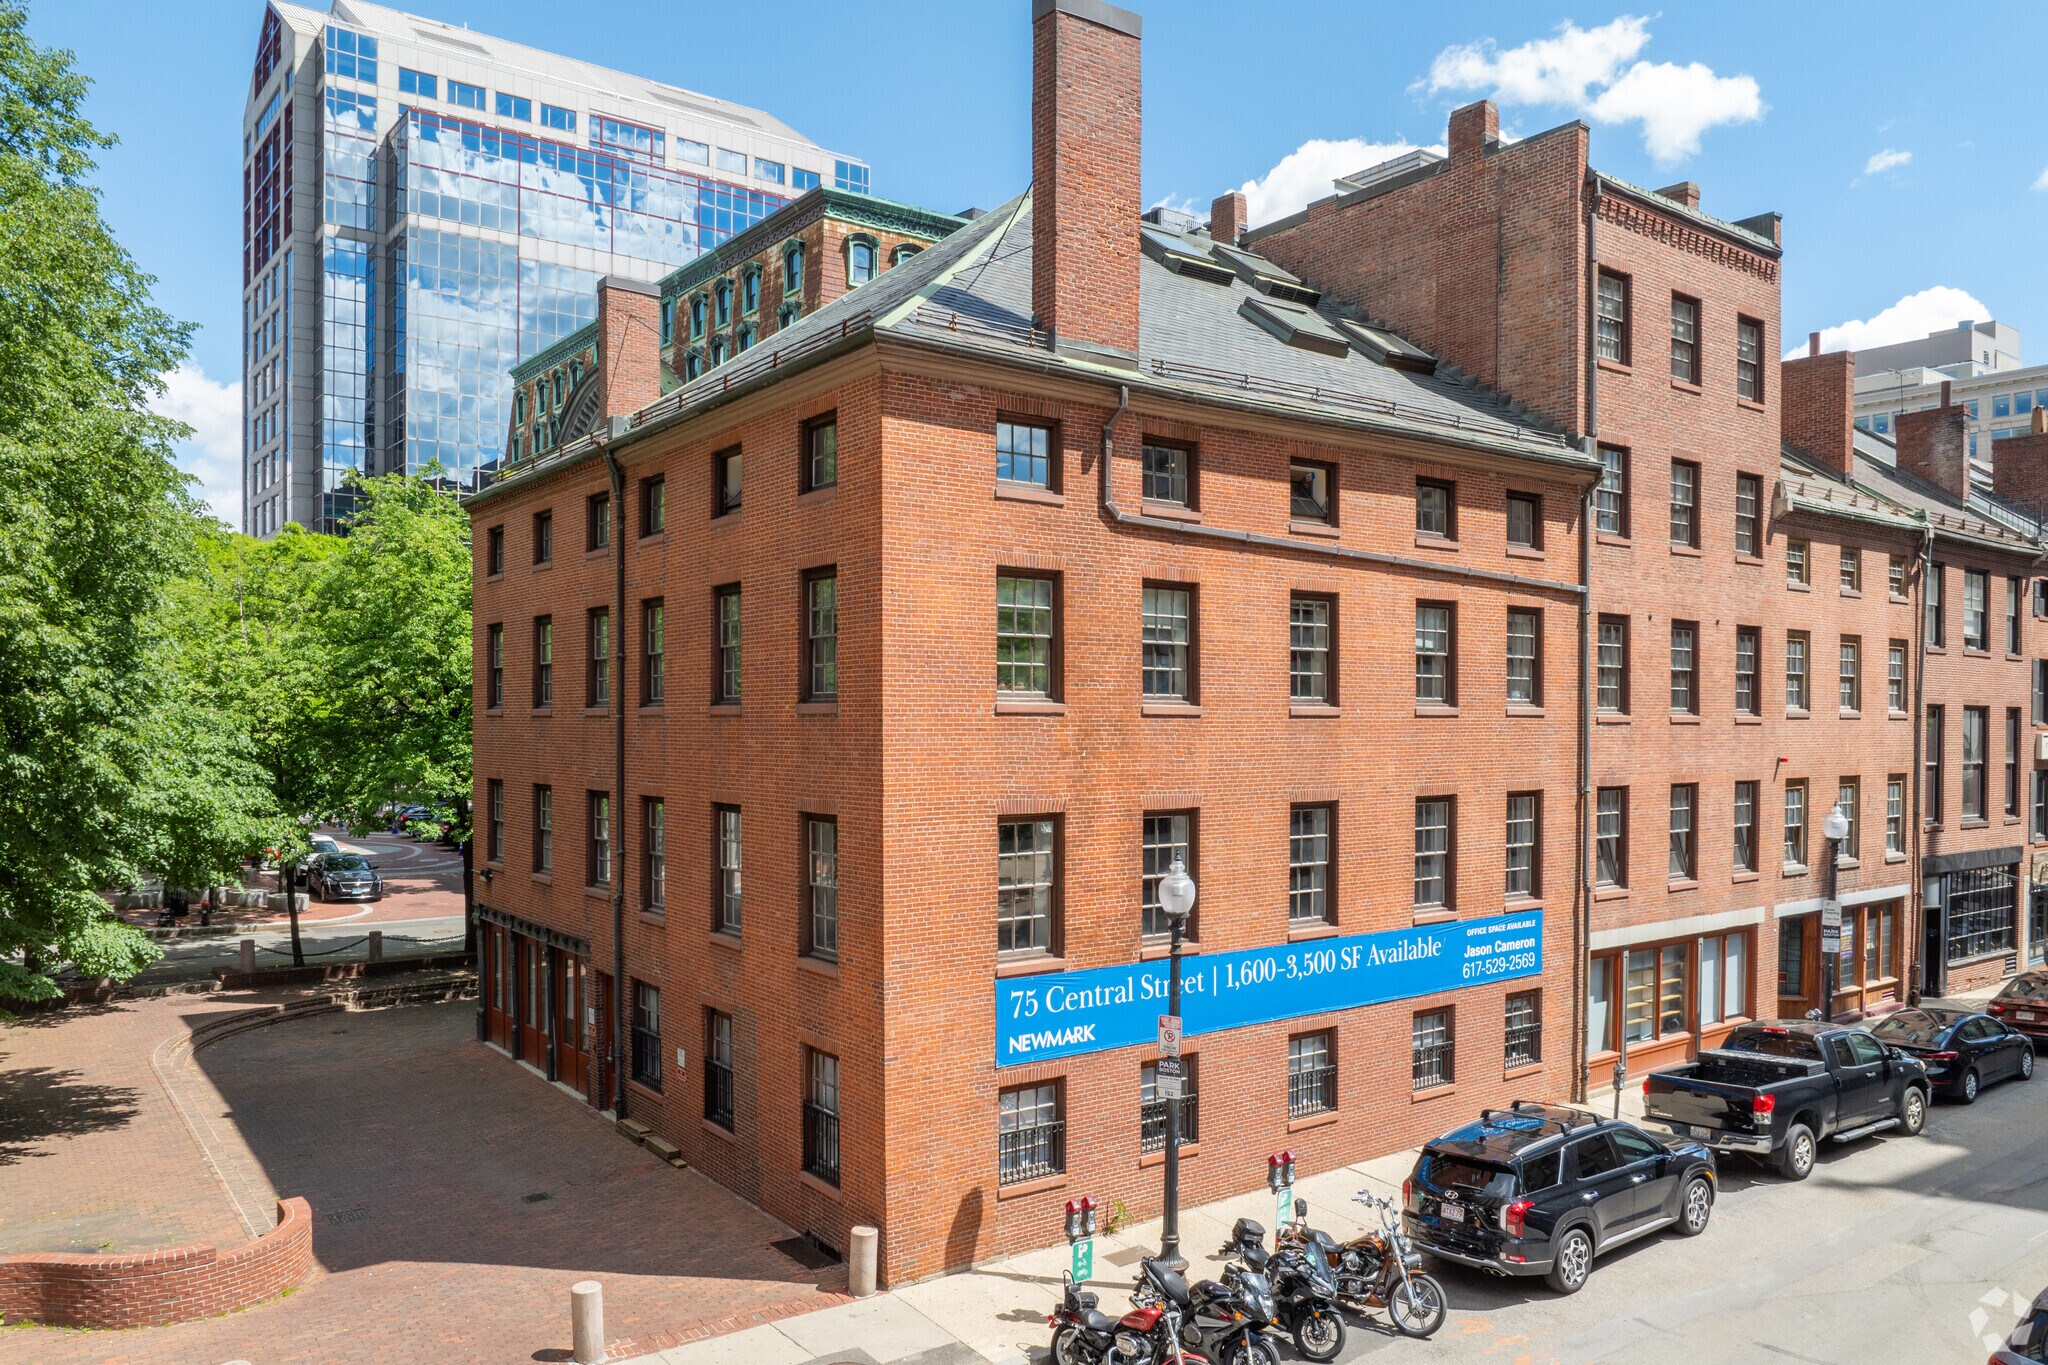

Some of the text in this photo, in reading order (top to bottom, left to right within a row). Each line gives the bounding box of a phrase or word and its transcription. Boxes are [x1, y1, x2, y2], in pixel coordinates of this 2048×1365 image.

[1466, 919, 1536, 937] OFFICE SPACE AVAILABLE
[1463, 937, 1536, 958] Jason Cameron
[1462, 951, 1536, 979] 617-529-2569
[1010, 988, 1039, 1019] 75
[1045, 976, 1135, 1013] Central
[1340, 945, 1363, 971] SF
[1366, 935, 1442, 967] Available
[1008, 1023, 1096, 1055] NEWMARK
[1158, 1060, 1180, 1070] PARK
[1158, 1067, 1181, 1075] BOSTON
